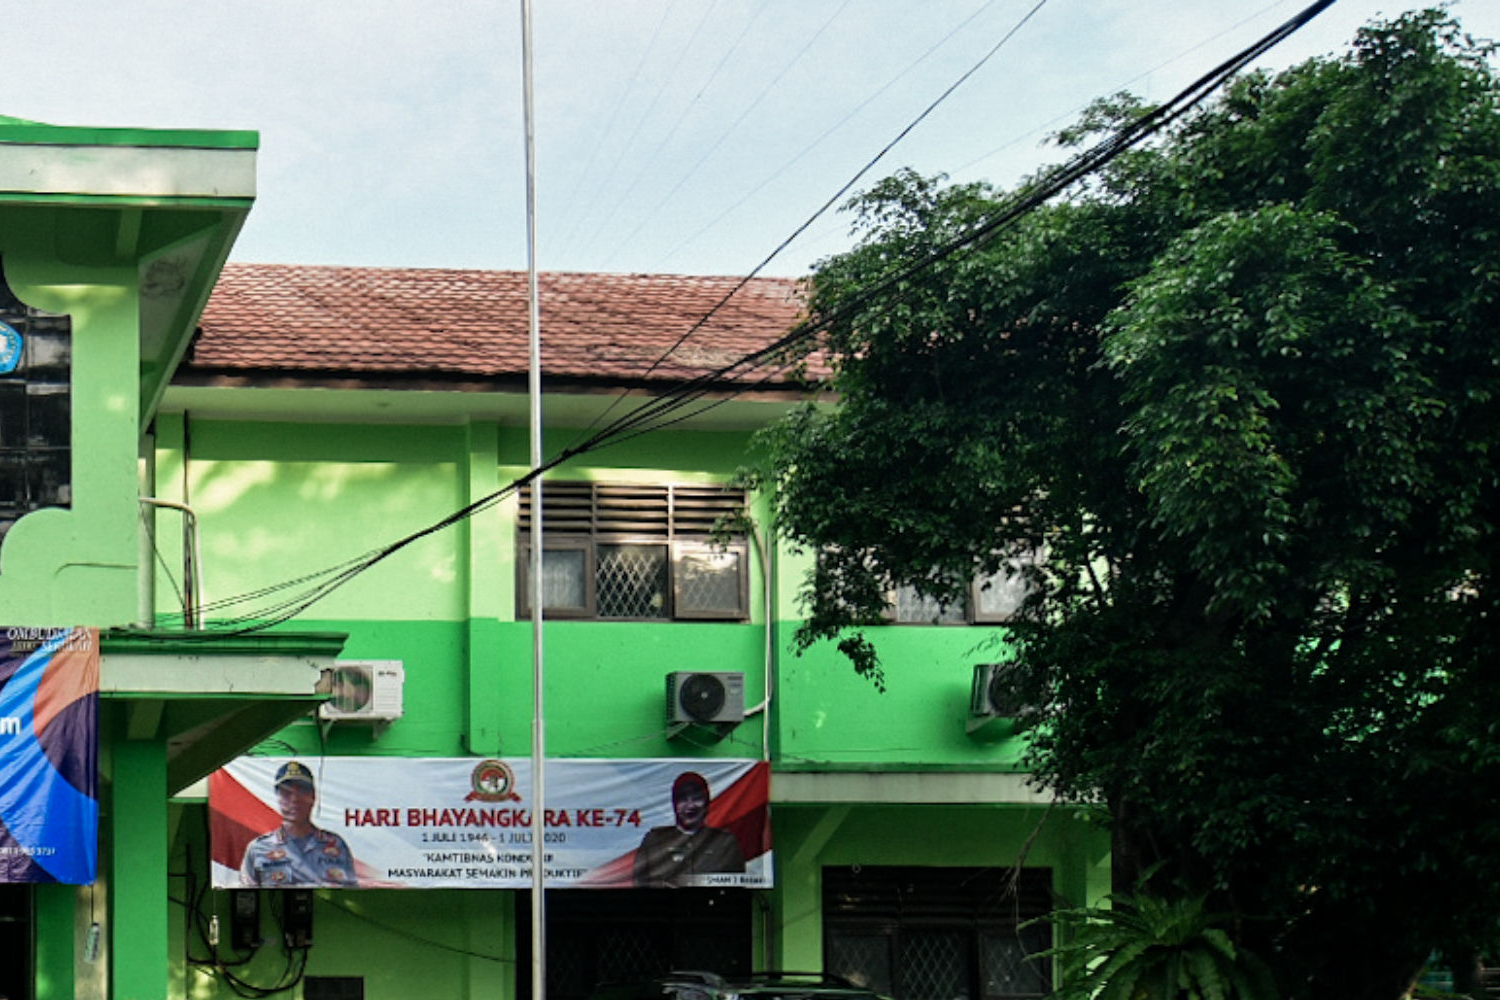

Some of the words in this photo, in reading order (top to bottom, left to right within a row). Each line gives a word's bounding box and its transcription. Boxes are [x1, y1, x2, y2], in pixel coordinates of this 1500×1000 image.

[345, 808, 400, 828] HARI
[577, 808, 642, 828] KE-74
[544, 832, 566, 844] 020
[388, 867, 462, 878] MASYARAKAT
[466, 868, 516, 879] SEMAKIN
